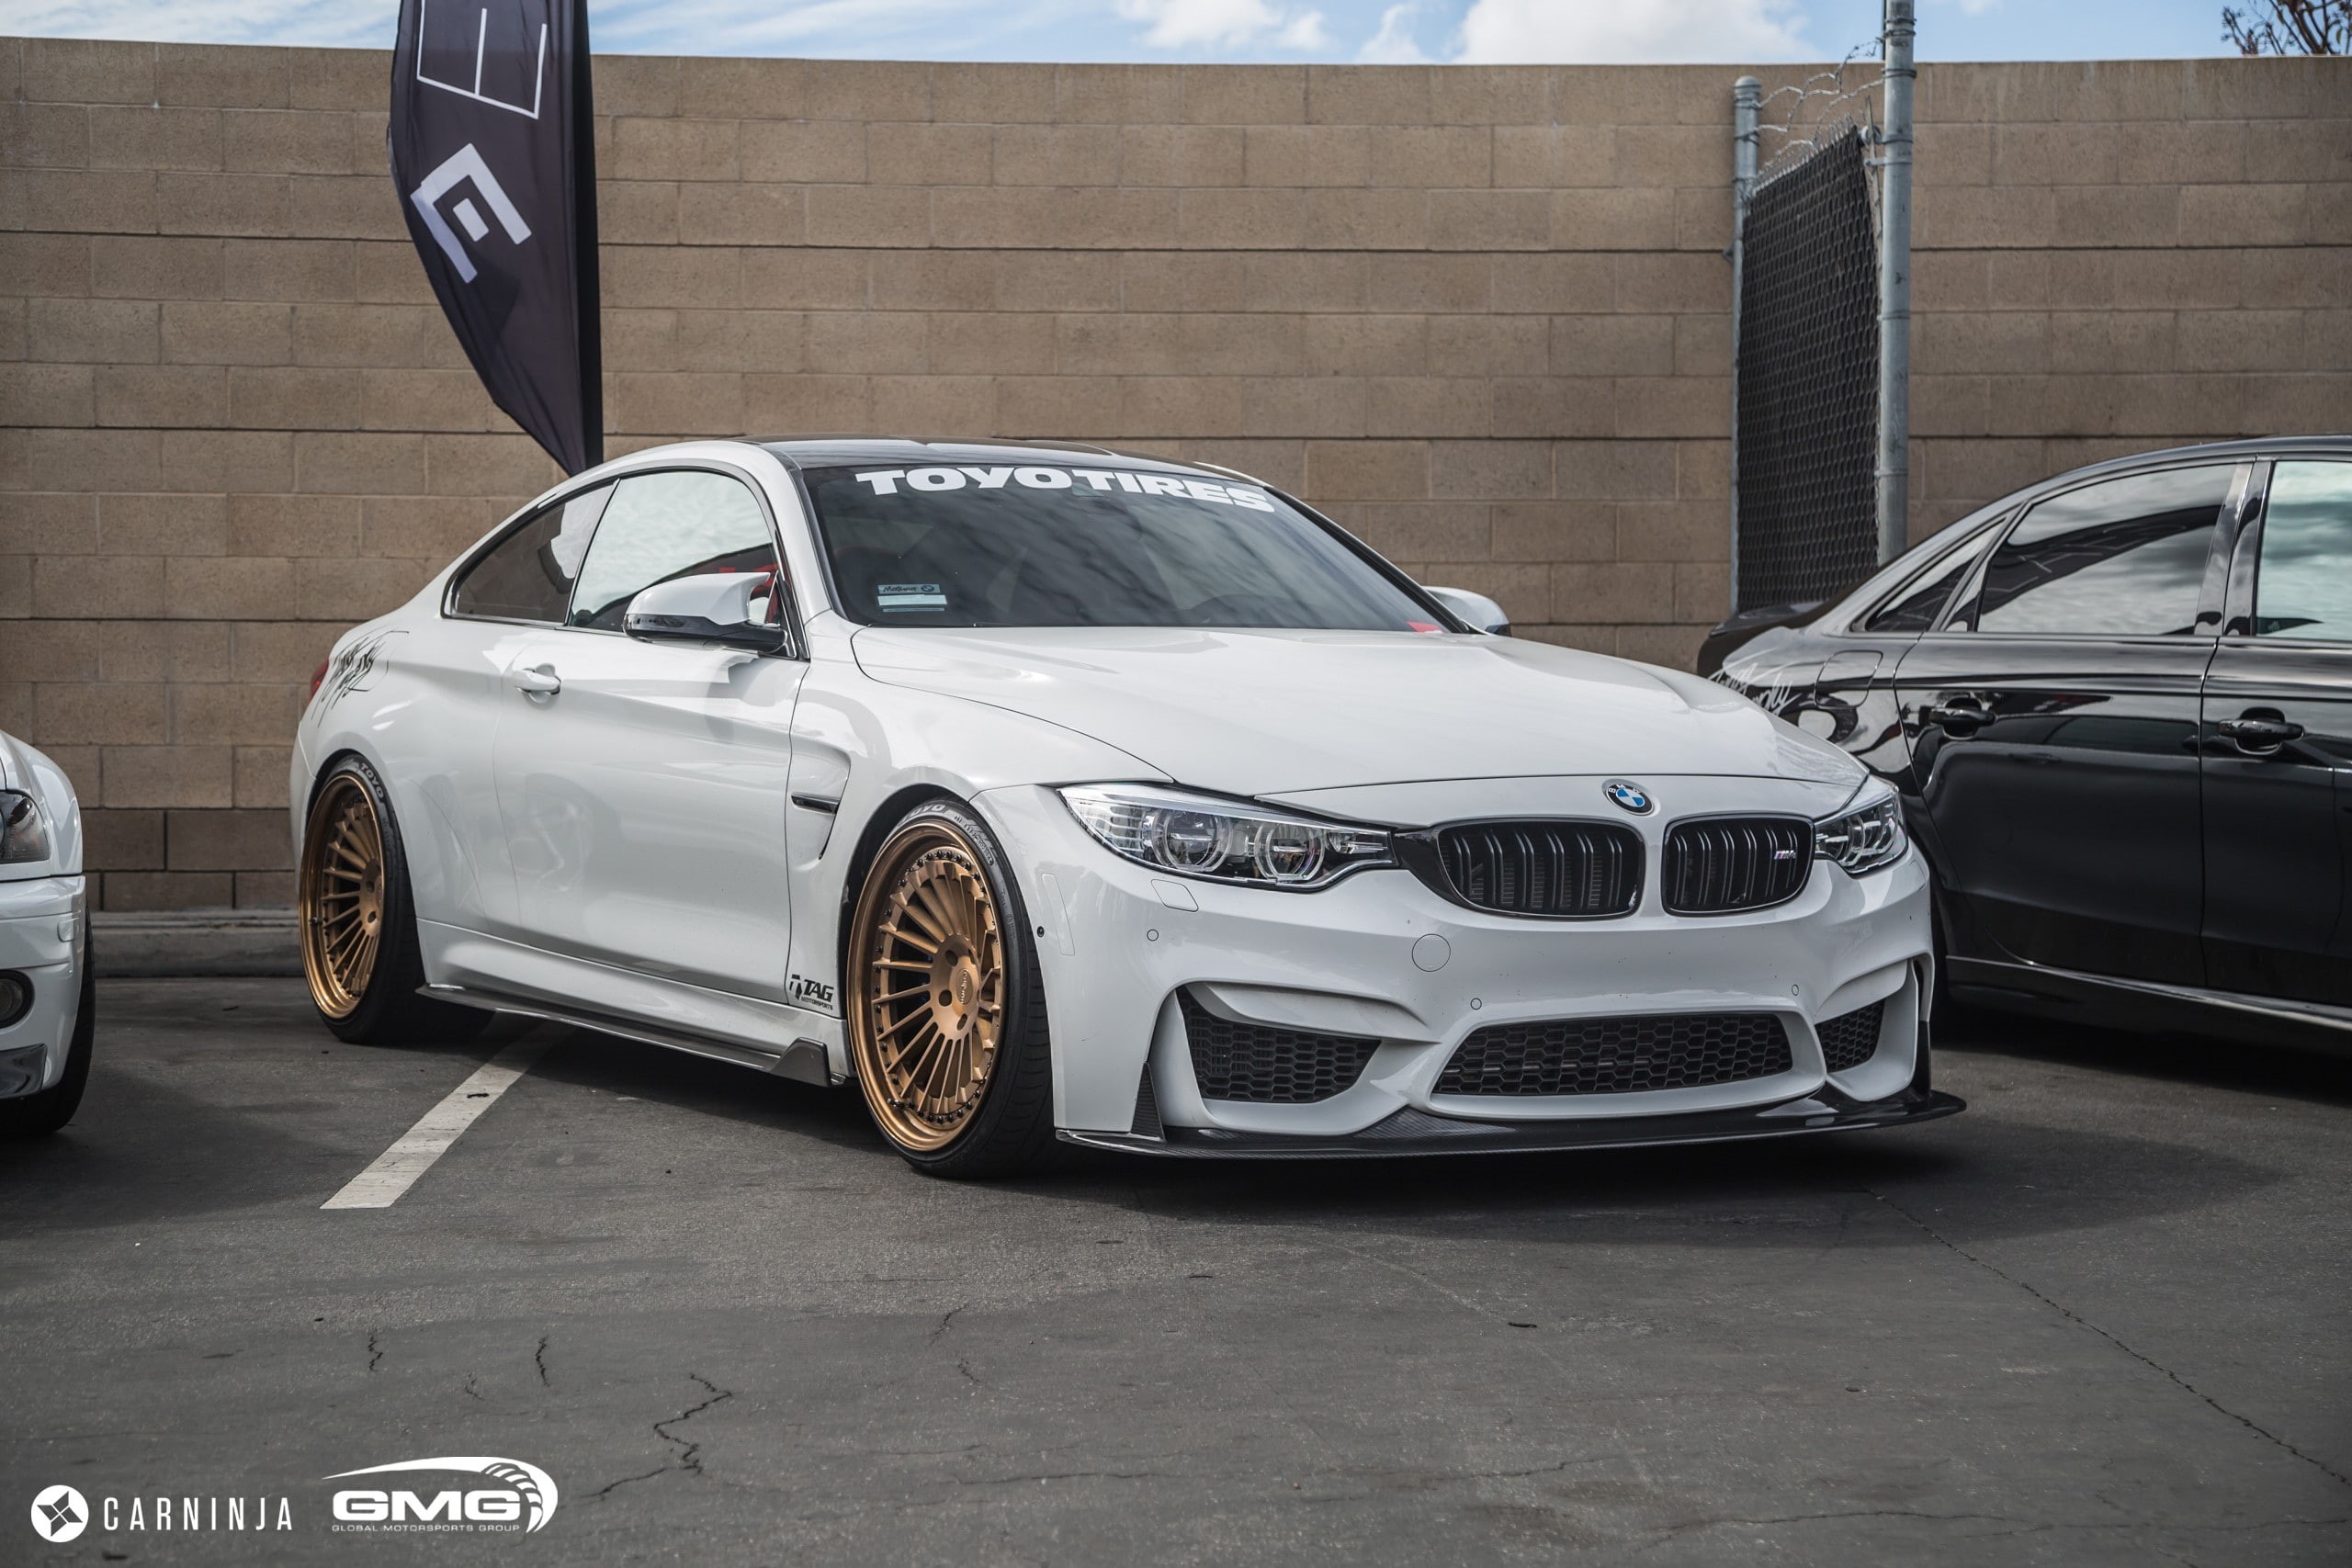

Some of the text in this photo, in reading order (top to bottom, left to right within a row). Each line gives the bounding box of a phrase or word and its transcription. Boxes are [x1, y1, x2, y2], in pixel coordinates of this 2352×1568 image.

[855, 467, 1275, 513] TOYO TIRES
[361, 762, 384, 798] TOYO
[804, 978, 834, 1002] TAG
